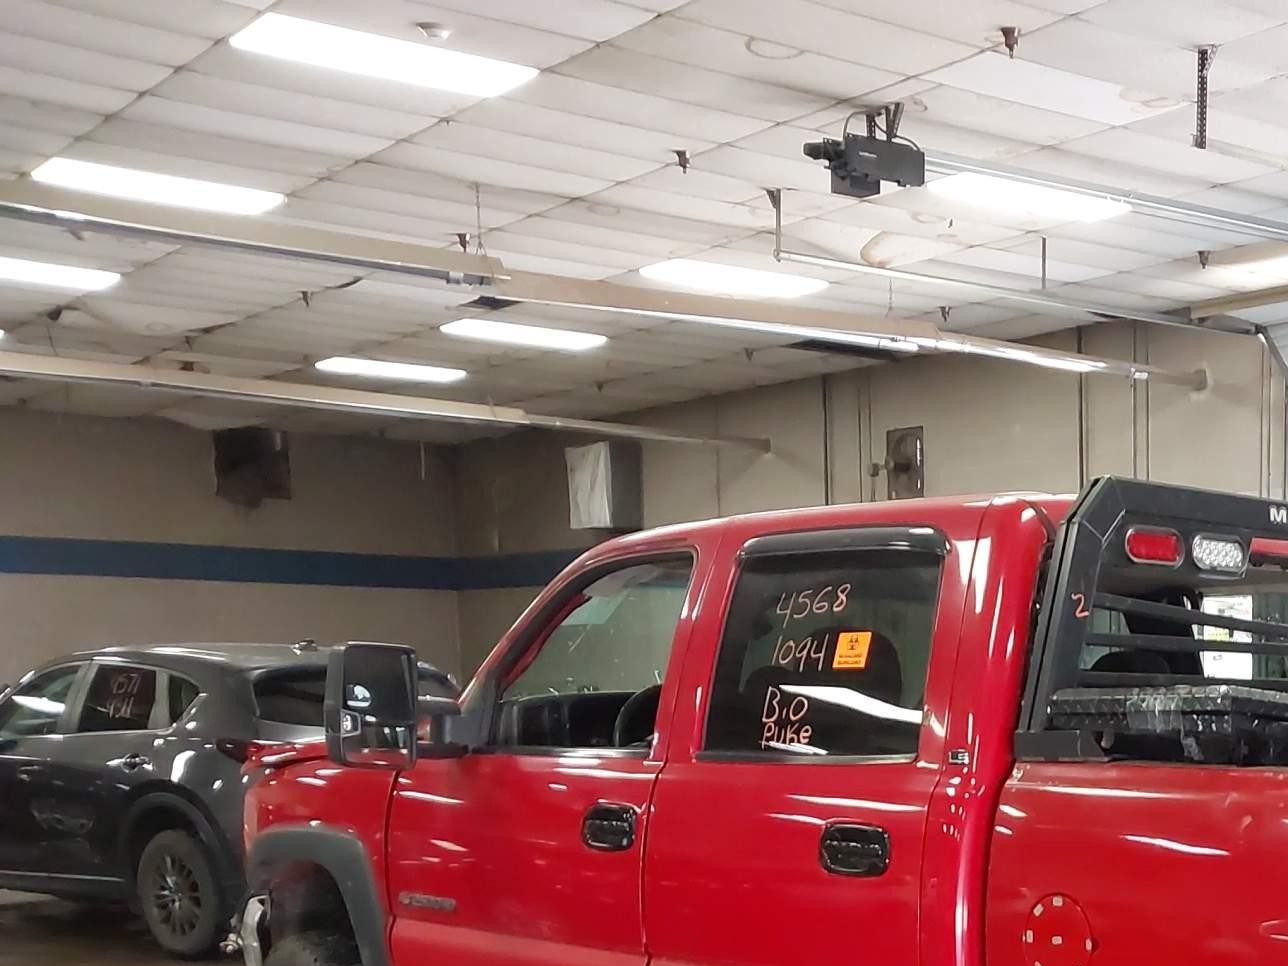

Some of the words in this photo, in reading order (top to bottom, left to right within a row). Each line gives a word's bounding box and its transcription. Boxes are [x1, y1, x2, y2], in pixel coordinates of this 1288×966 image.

[776, 583, 852, 629] 4568
[1071, 592, 1090, 618] 2
[771, 633, 830, 673] 1094
